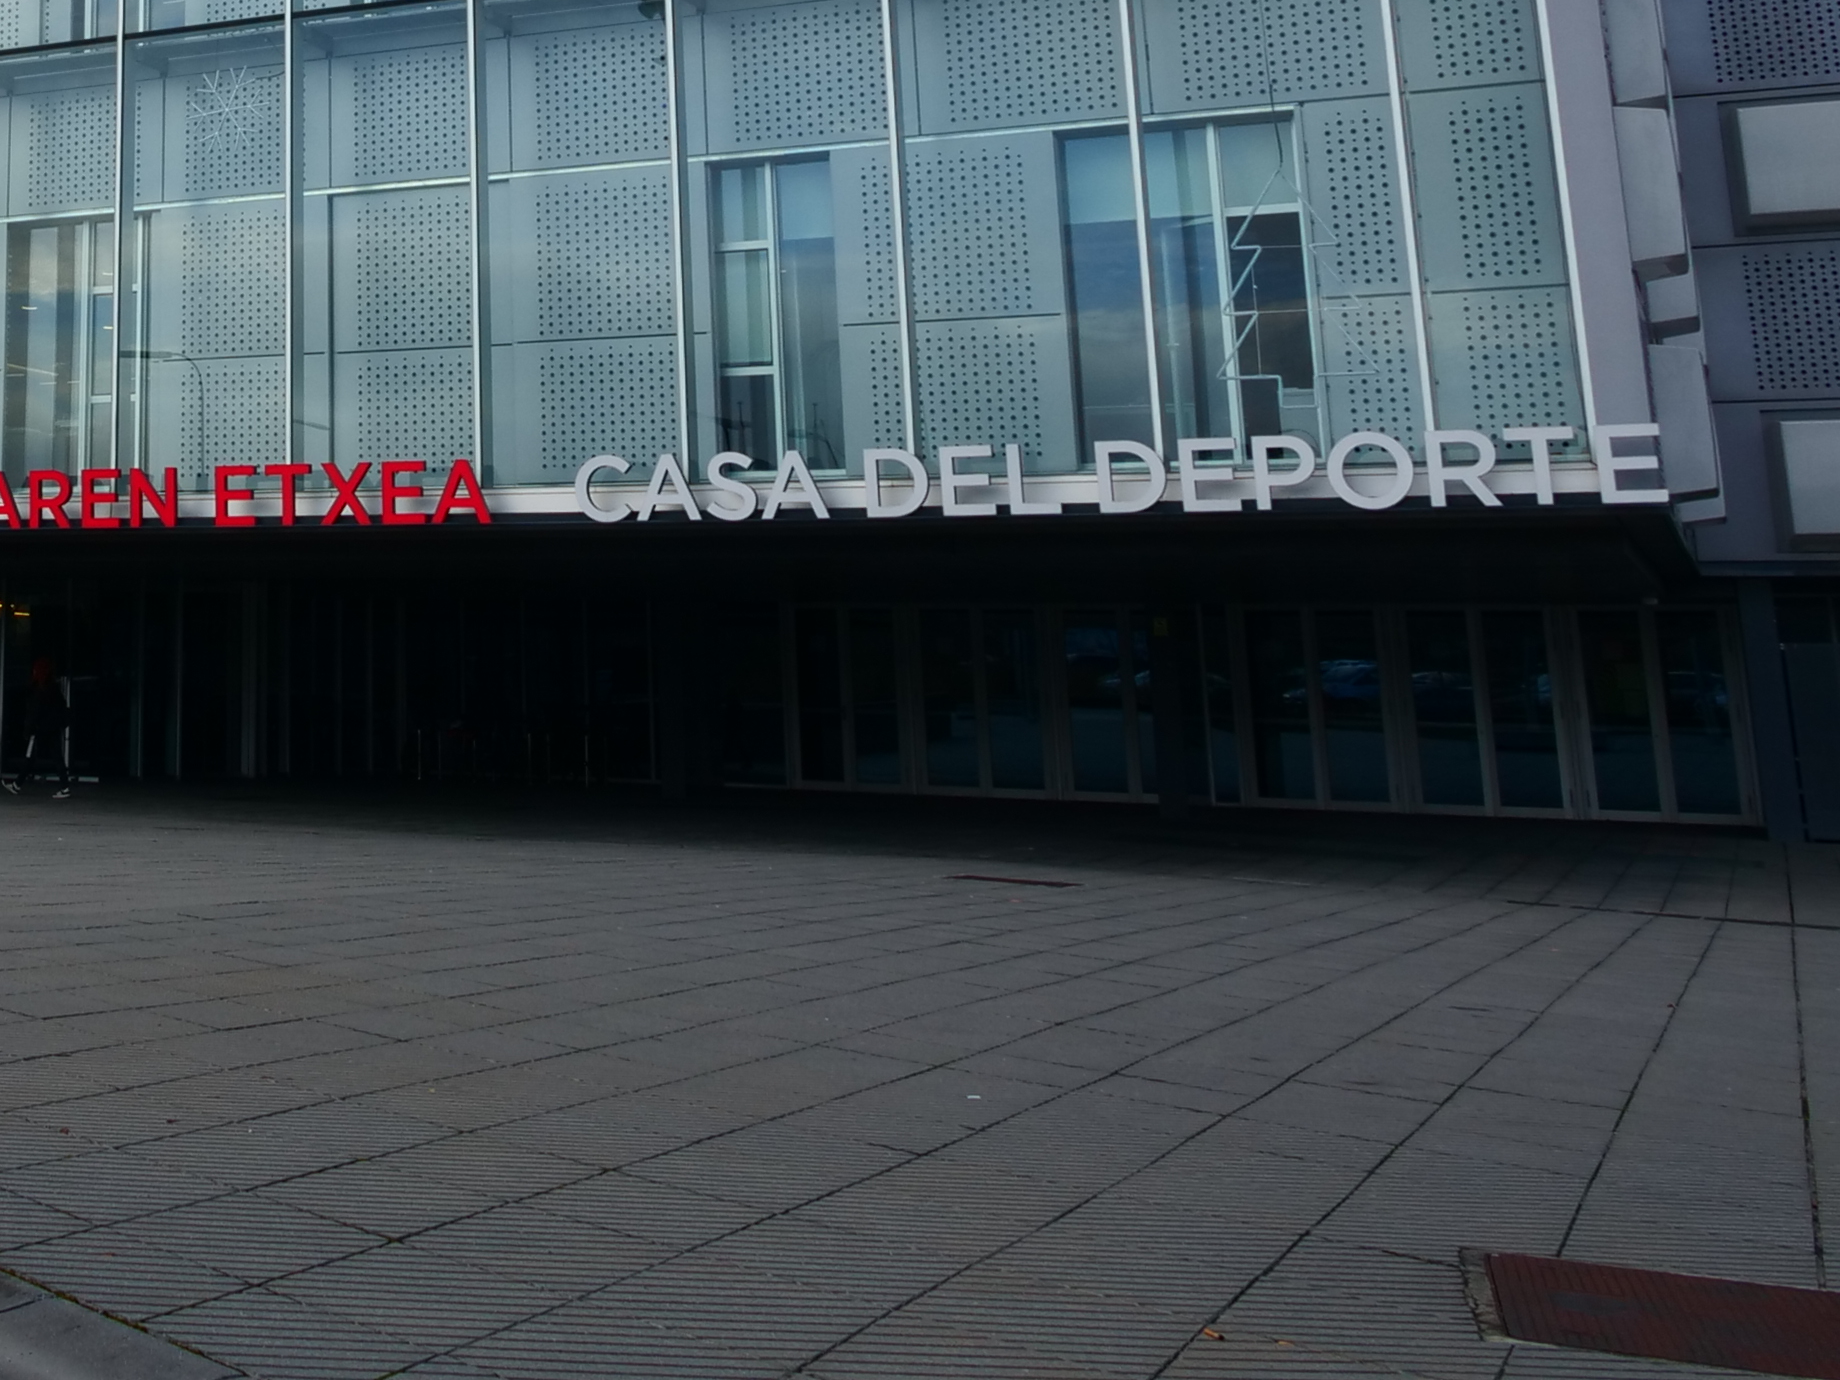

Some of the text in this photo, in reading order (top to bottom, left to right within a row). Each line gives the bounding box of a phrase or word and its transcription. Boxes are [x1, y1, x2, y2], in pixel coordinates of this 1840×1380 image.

[214, 459, 493, 526] ETXEA
[573, 423, 1670, 523] CASA DEL DEPORTE
